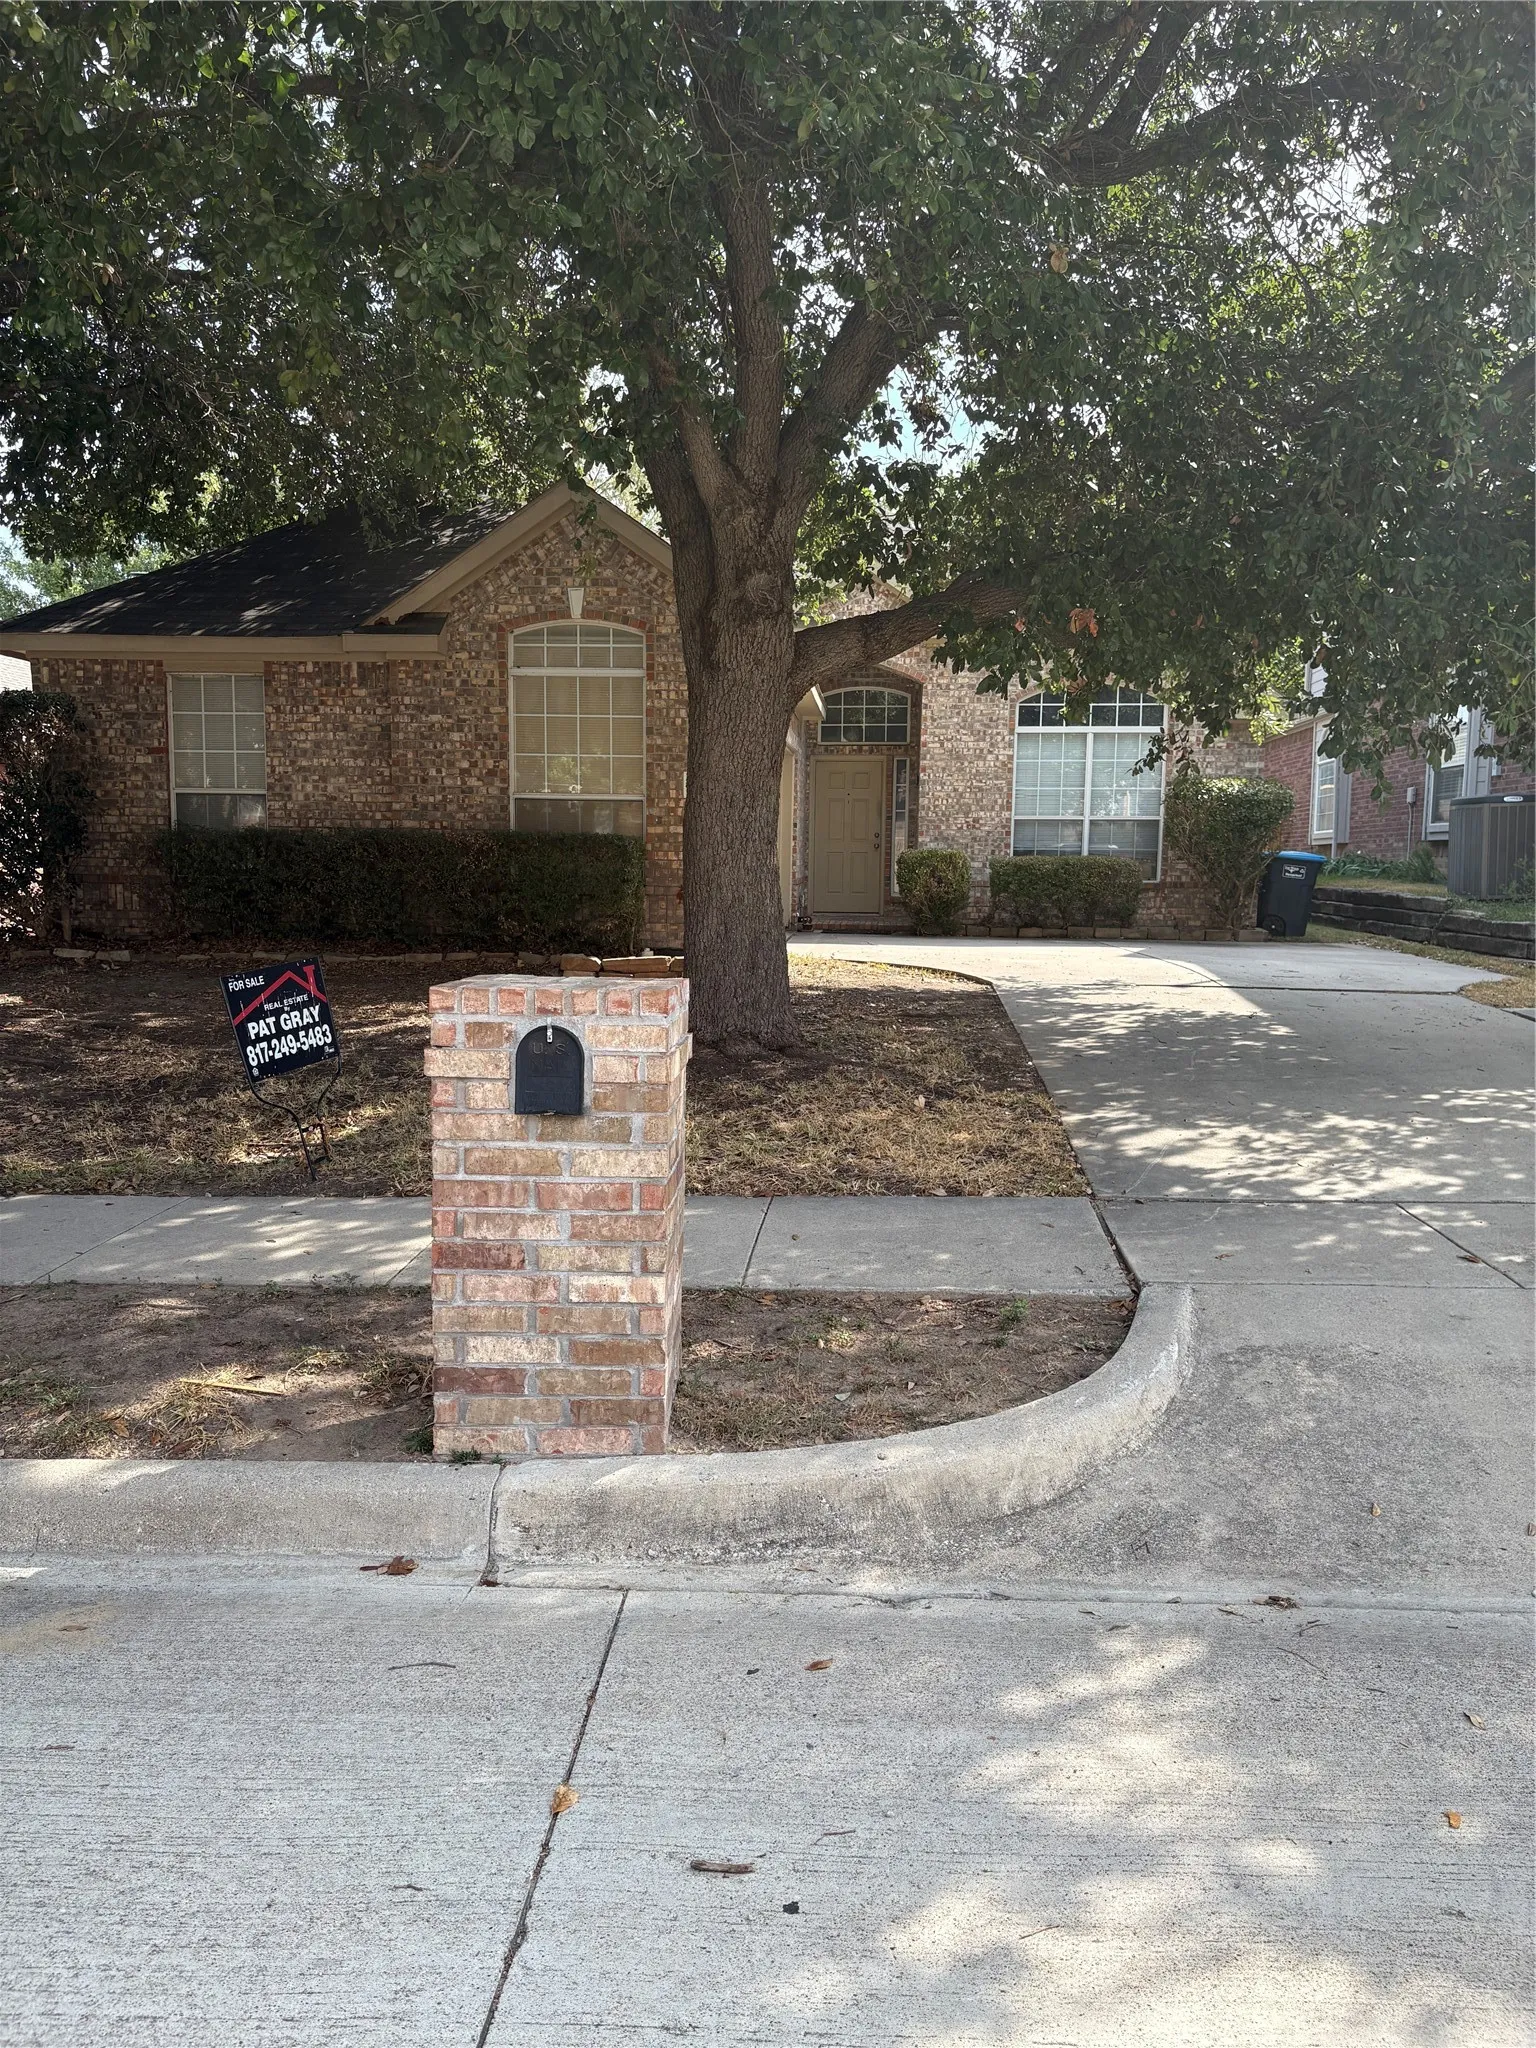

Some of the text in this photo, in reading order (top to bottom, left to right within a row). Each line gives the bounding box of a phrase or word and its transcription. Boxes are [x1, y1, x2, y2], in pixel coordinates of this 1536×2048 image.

[228, 976, 265, 992] FOR SALE
[264, 995, 308, 1011] REAL ESTATE
[248, 1005, 320, 1039] PAT GRAY
[246, 1024, 332, 1066] 817-249-5483
